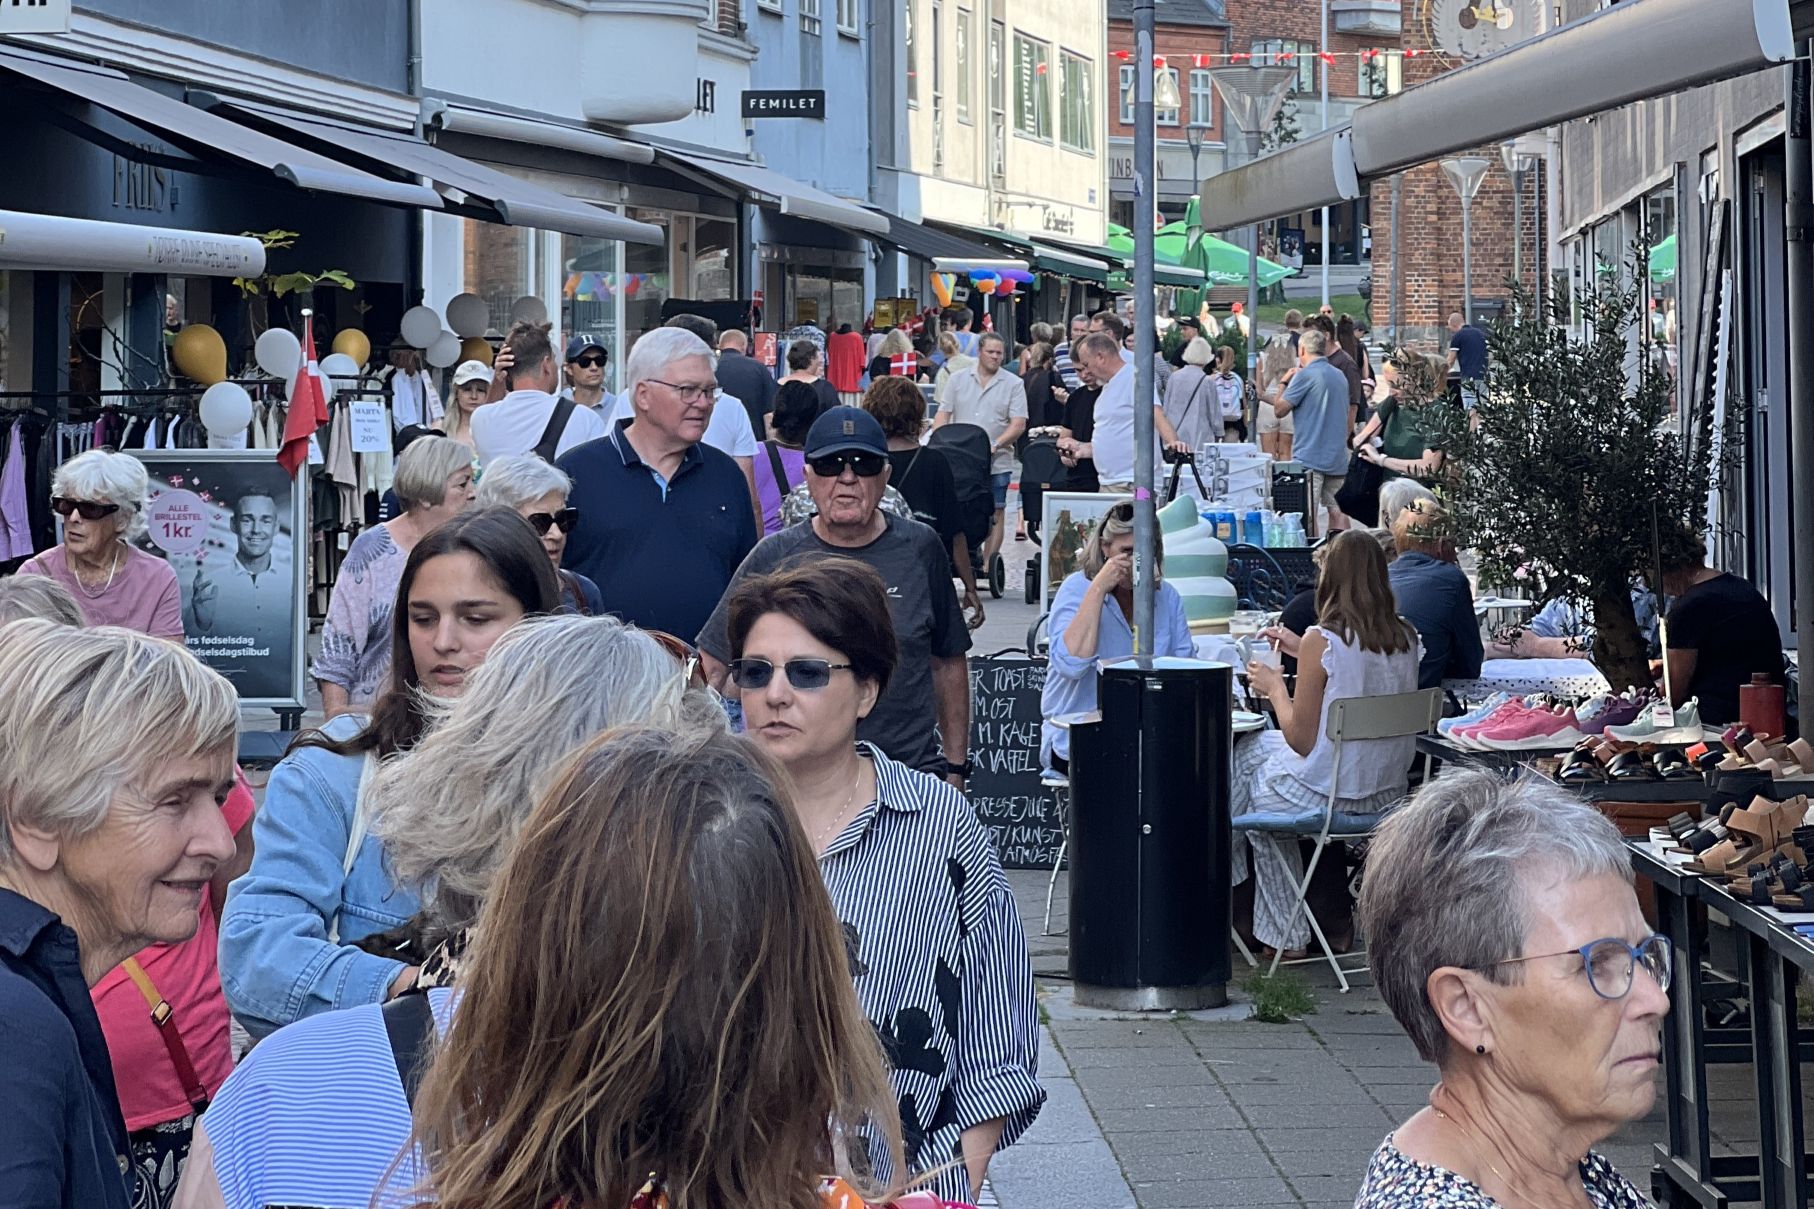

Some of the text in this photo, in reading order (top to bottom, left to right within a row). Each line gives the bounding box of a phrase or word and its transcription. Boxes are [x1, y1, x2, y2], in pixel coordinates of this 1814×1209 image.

[749, 98, 816, 109] FEMILET
[763, 332, 777, 366] SALE
[154, 513, 202, 521] BRILLESTEL
[168, 504, 189, 512] ALLE
[201, 635, 255, 646] fødselsdag
[991, 667, 1027, 692] TOAST
[991, 697, 1016, 719] OST
[999, 721, 1040, 747] KAGE
[989, 749, 1037, 774] VAFFEL
